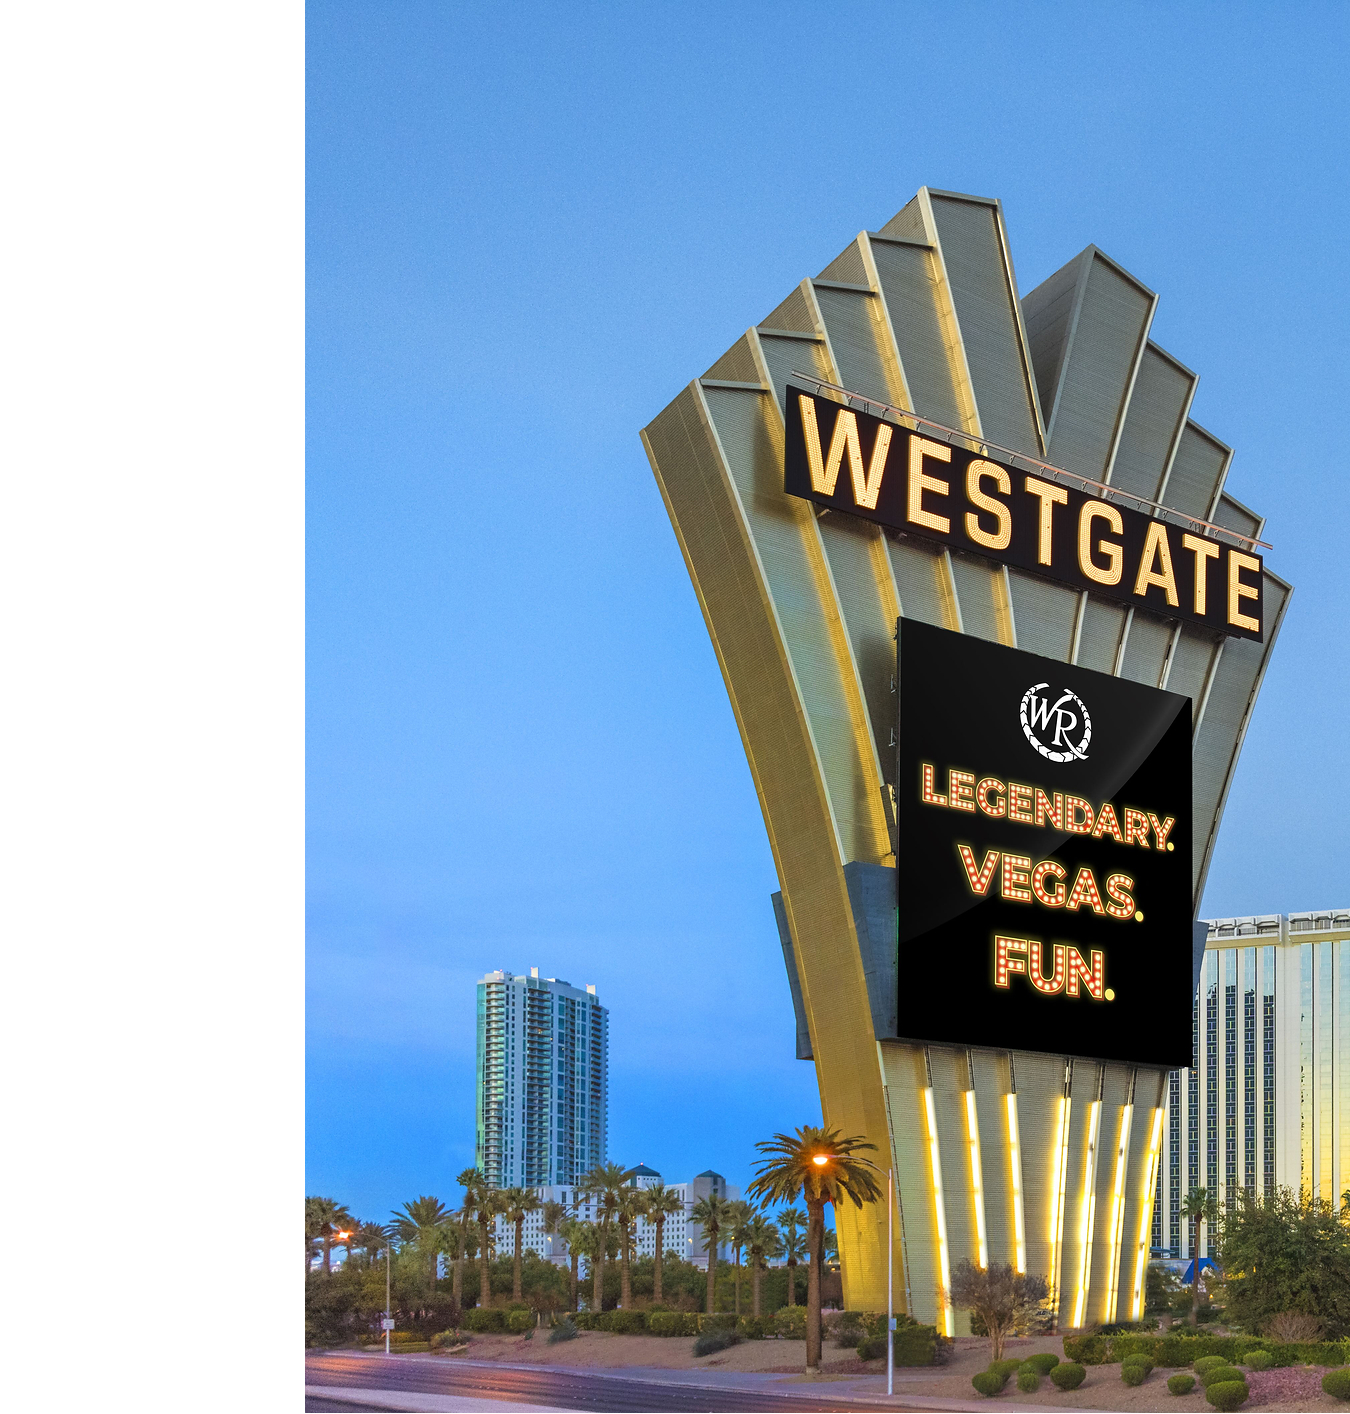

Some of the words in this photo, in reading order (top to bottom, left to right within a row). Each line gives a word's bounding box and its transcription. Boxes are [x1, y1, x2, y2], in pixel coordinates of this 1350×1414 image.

[798, 394, 1260, 632] WESTGATE
[1029, 693, 1089, 760] WR
[922, 763, 1175, 851] LEGENDARY.
[957, 844, 1144, 922] VEGAS.
[994, 935, 1115, 1001] FUN.
